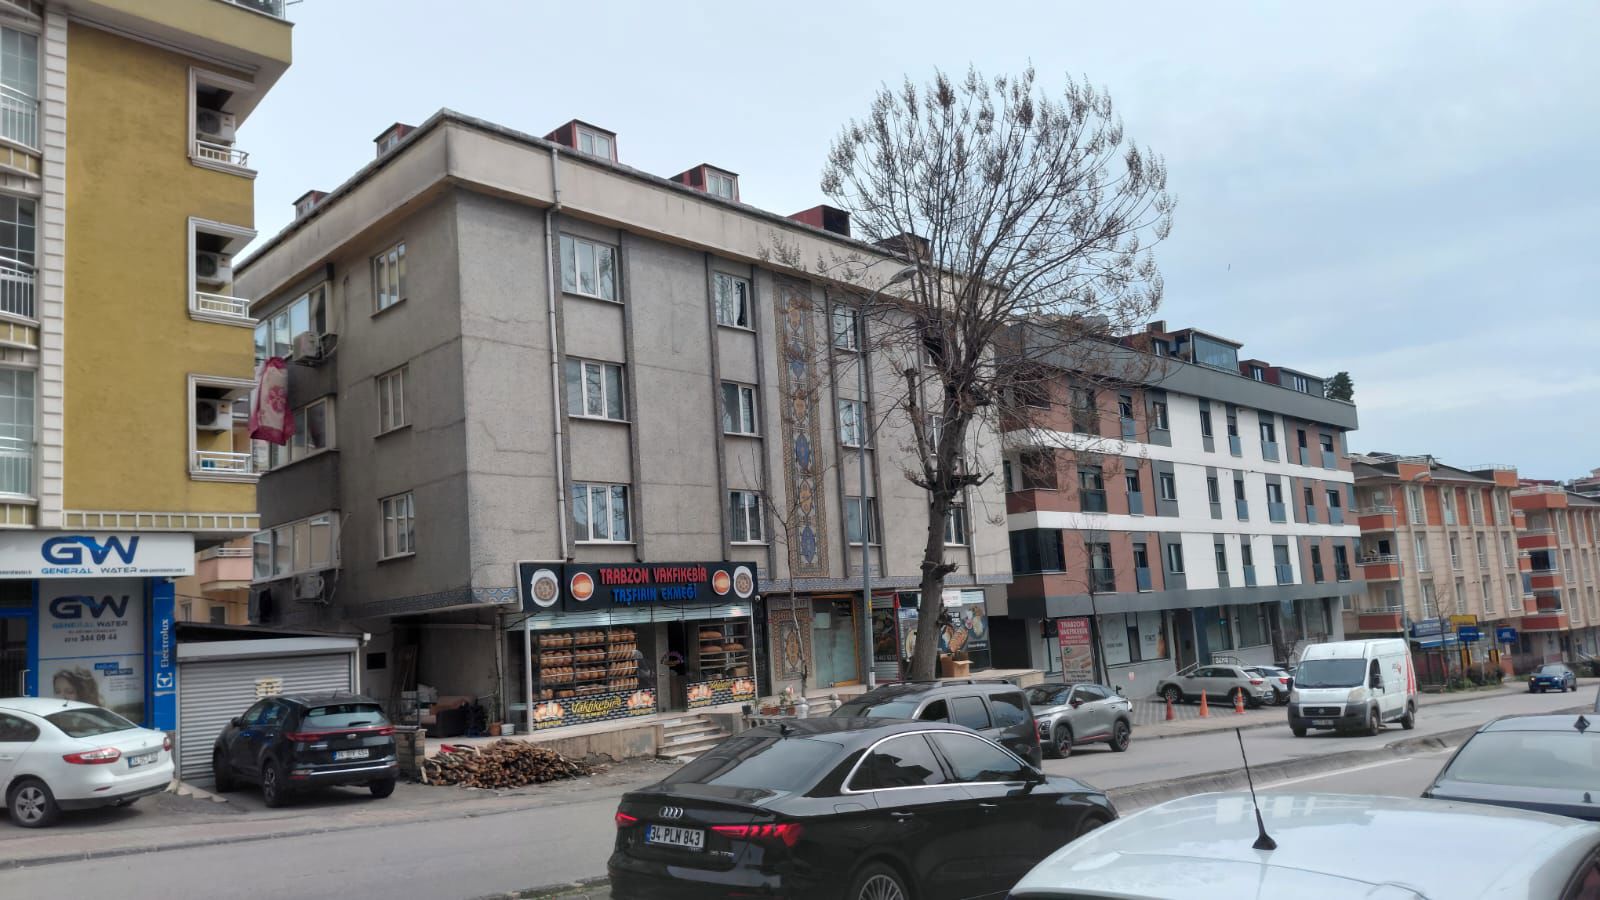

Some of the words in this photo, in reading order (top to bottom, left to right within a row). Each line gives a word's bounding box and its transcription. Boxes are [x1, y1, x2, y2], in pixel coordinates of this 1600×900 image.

[41, 535, 140, 565] GW
[600, 567, 649, 585] TRABZON
[49, 595, 130, 619] GW
[160, 618, 169, 668] Electrolux
[650, 825, 660, 840] 34
[663, 828, 681, 843] PLN
[683, 830, 700, 845] 843
